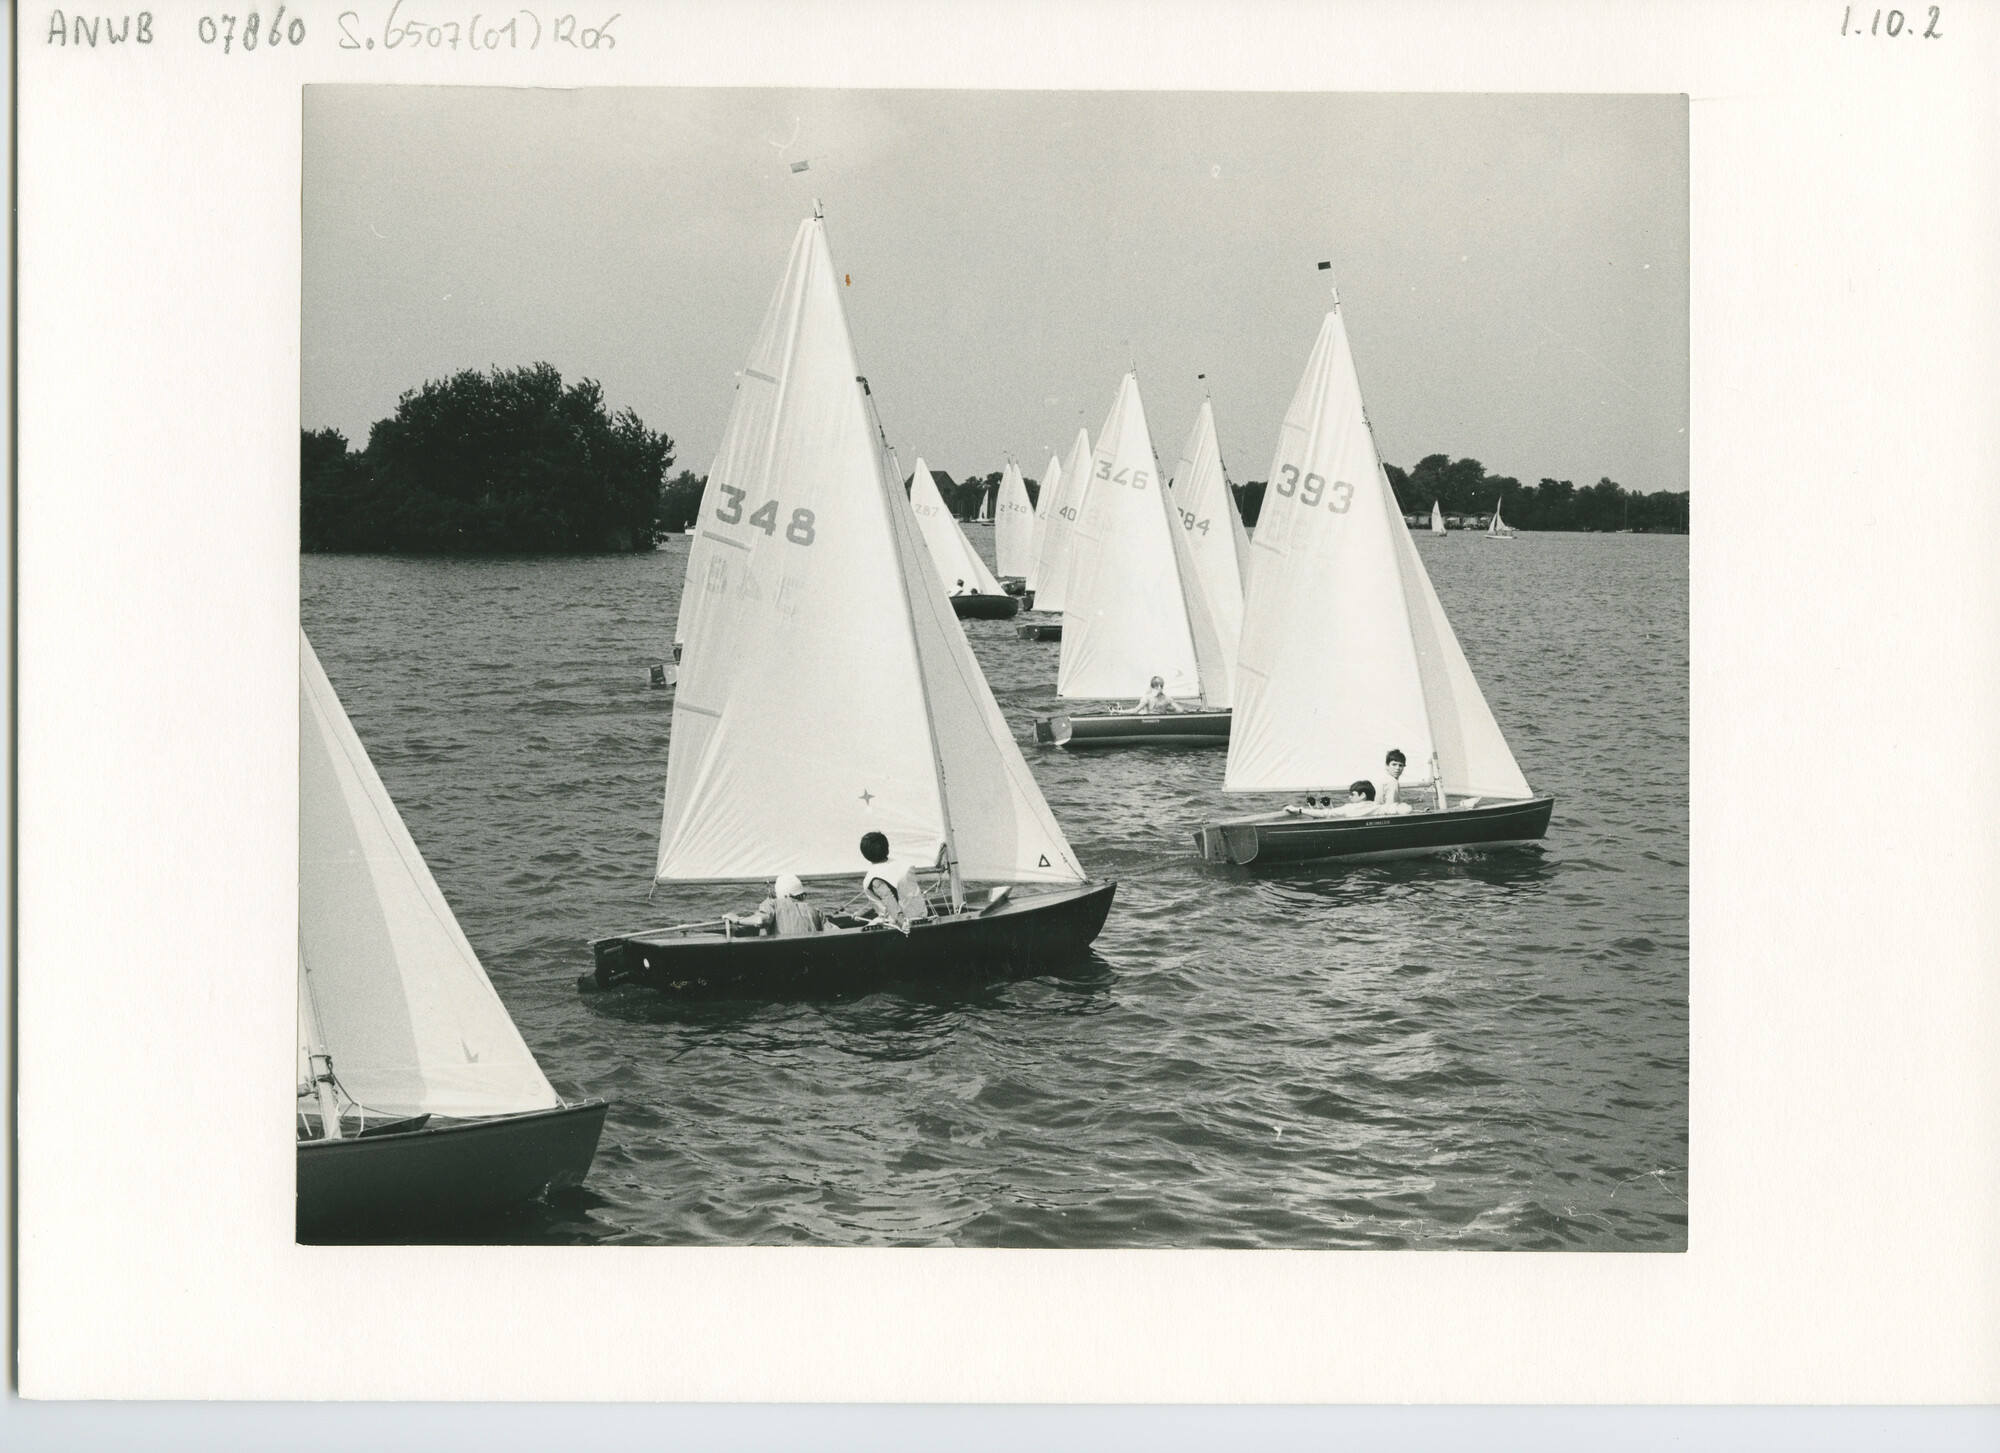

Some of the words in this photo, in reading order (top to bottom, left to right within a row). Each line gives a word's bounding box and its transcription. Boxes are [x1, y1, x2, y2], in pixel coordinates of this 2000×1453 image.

[48, 9, 153, 48] ANWB
[199, 5, 306, 54] 07860
[1096, 459, 1149, 490] 346
[1276, 463, 1354, 514] 393
[715, 482, 816, 546] 348
